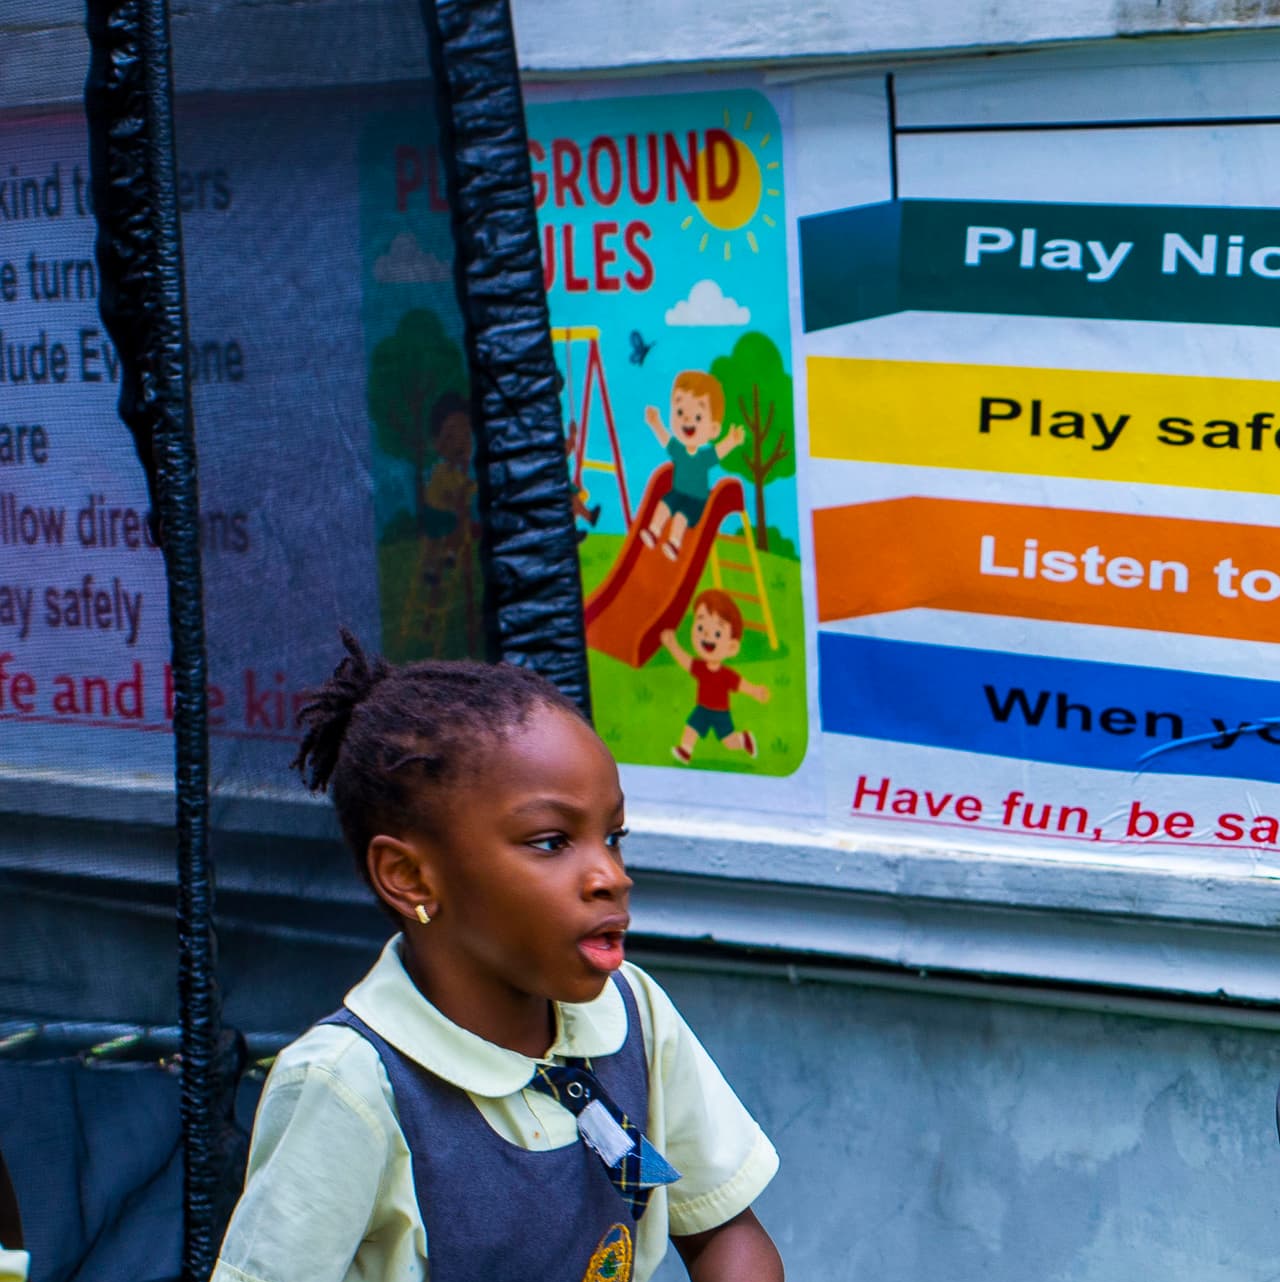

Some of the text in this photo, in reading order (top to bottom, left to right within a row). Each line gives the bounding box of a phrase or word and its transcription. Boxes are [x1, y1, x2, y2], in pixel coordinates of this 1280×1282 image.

[964, 226, 1132, 281] Play
[978, 396, 1132, 452] Play
[979, 534, 1190, 594] Listen
[44, 573, 143, 648] safely
[53, 661, 143, 719] and
[982, 683, 1185, 741] When
[852, 774, 985, 823] Have
[1002, 789, 1105, 843] fun,
[1126, 800, 1197, 841] be
